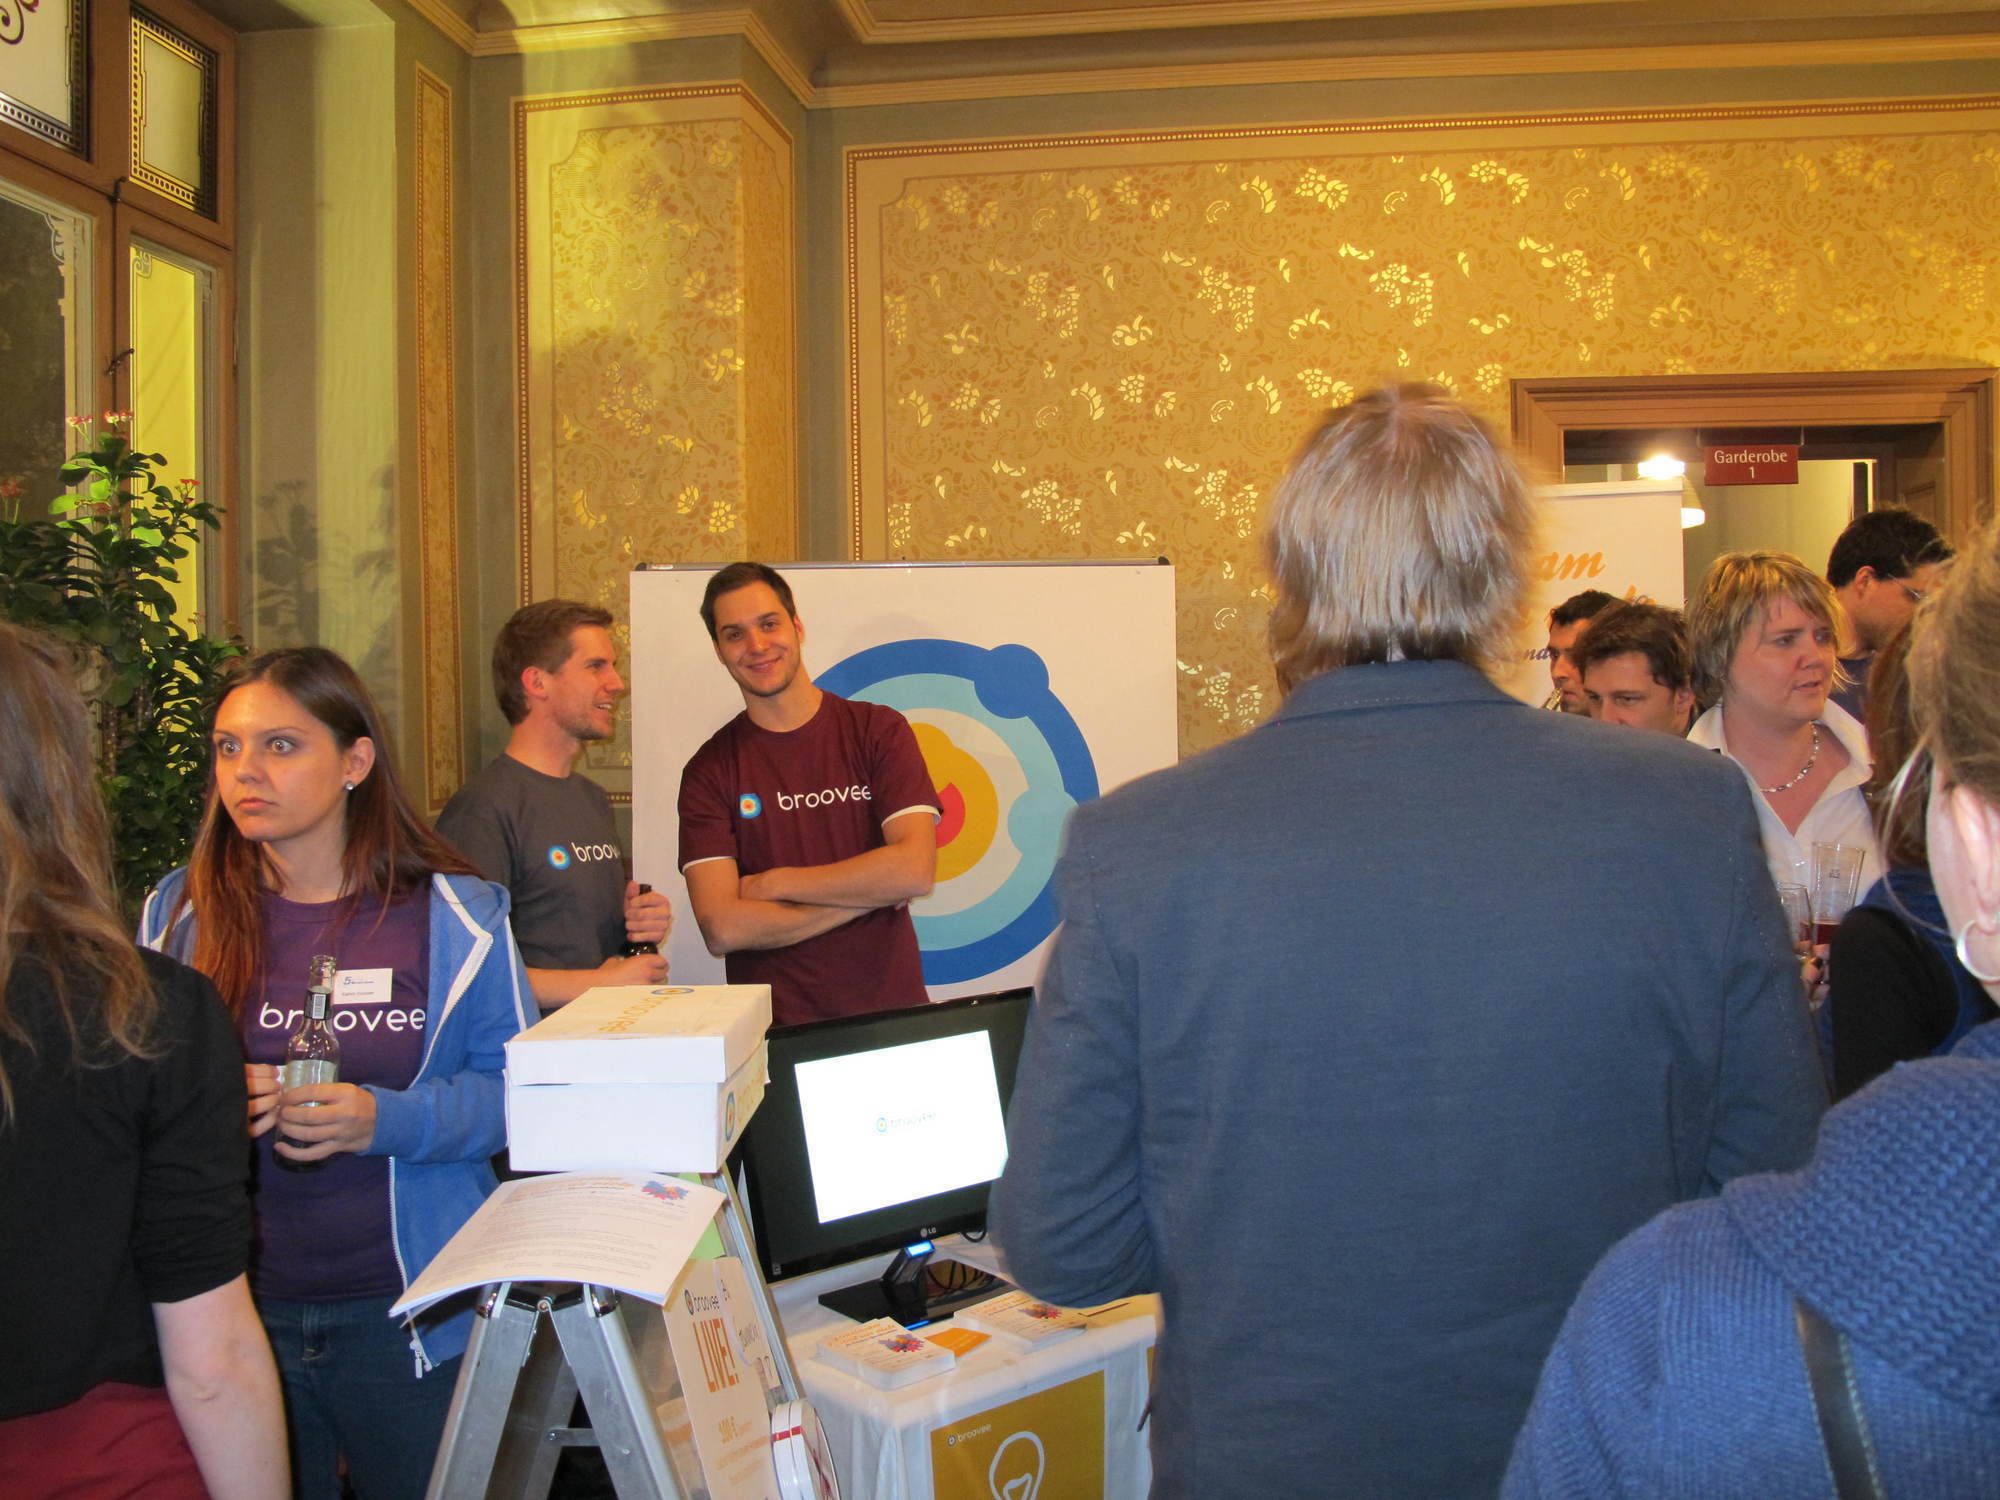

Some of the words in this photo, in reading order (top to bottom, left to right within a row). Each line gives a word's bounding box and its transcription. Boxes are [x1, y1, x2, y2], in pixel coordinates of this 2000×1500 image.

[1714, 449, 1788, 464] Garderobe
[1748, 466, 1755, 479] 1
[1534, 551, 1606, 581] am
[777, 785, 872, 811] broovee
[259, 1002, 426, 1032] brovee
[693, 1293, 720, 1314] broovee
[692, 1317, 740, 1394] LIVE!
